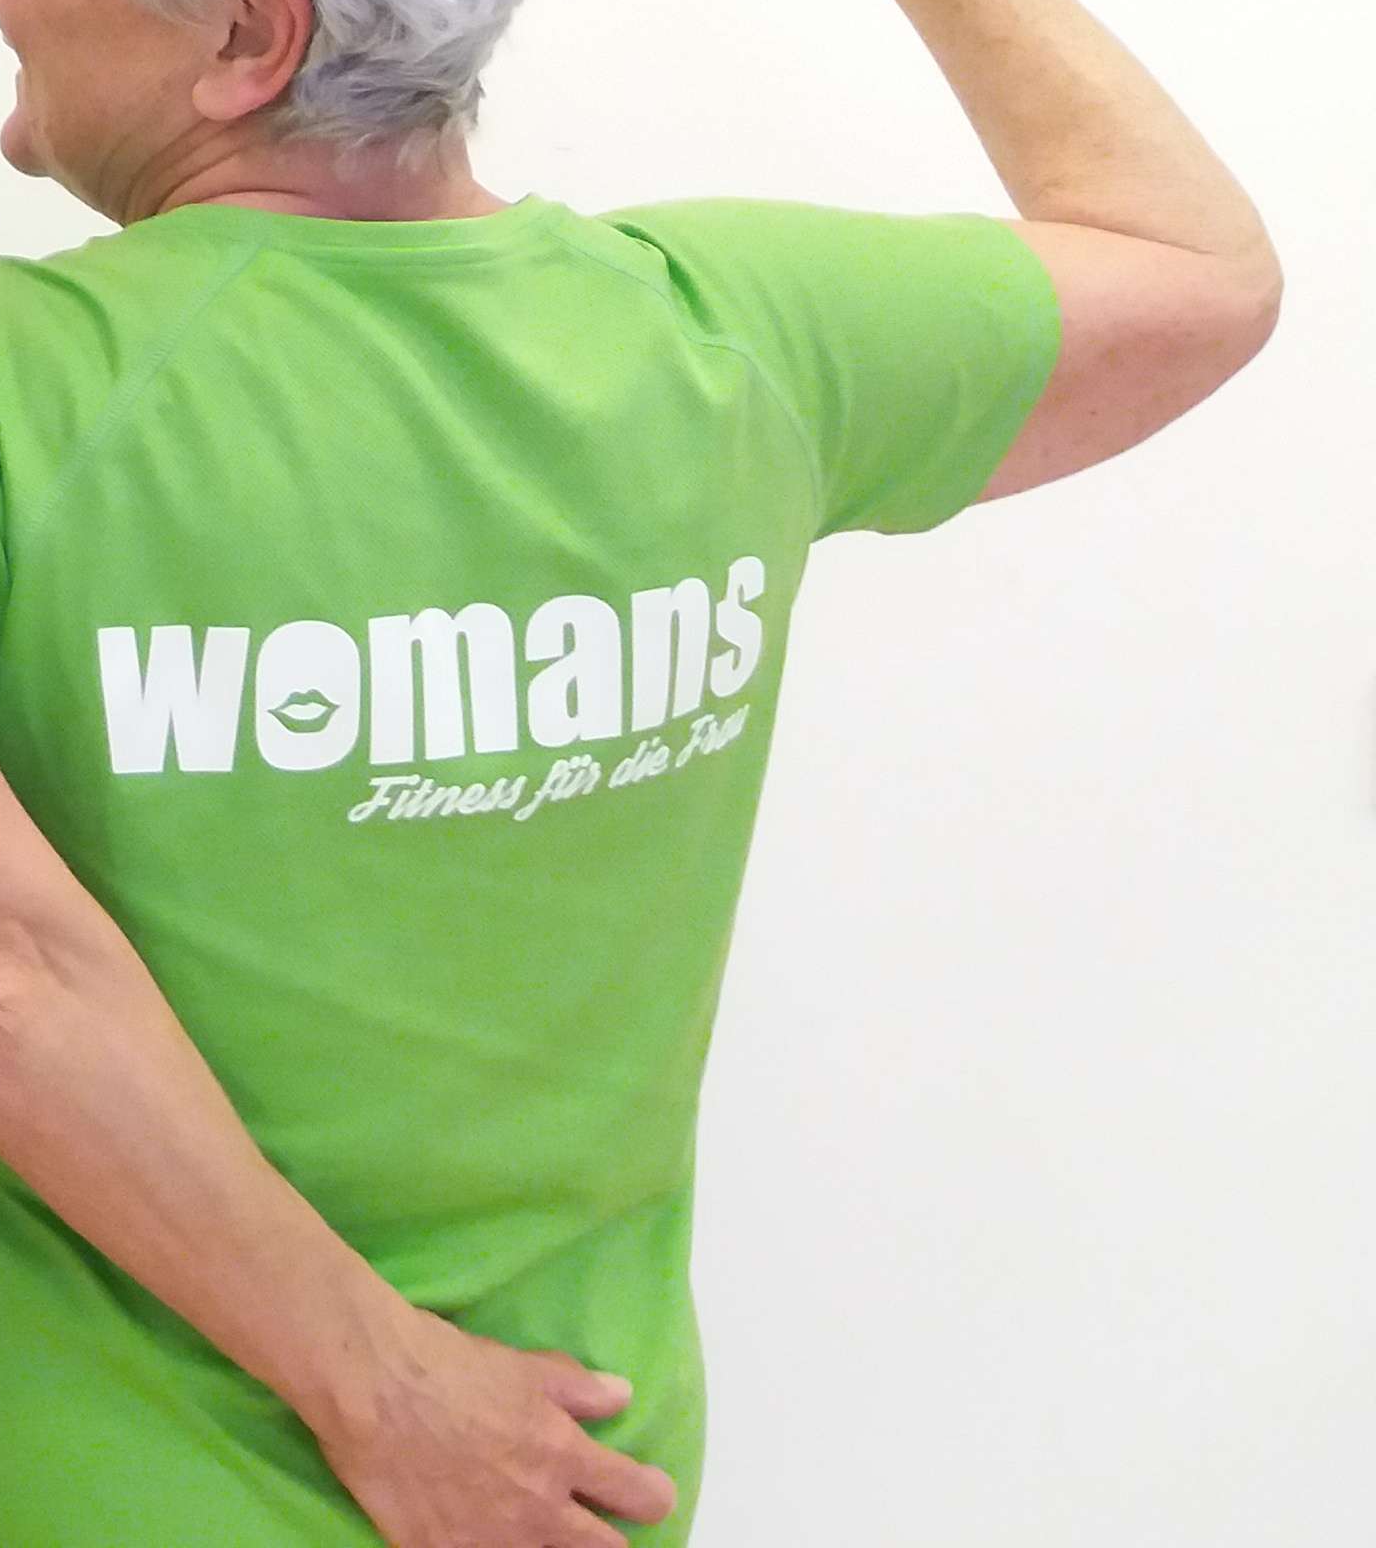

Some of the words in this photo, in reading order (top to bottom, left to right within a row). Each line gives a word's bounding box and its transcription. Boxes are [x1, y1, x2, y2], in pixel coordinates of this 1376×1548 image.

[97, 555, 765, 774] womans
[348, 773, 528, 823] Fitness
[514, 754, 602, 822] für
[608, 737, 670, 789] die
